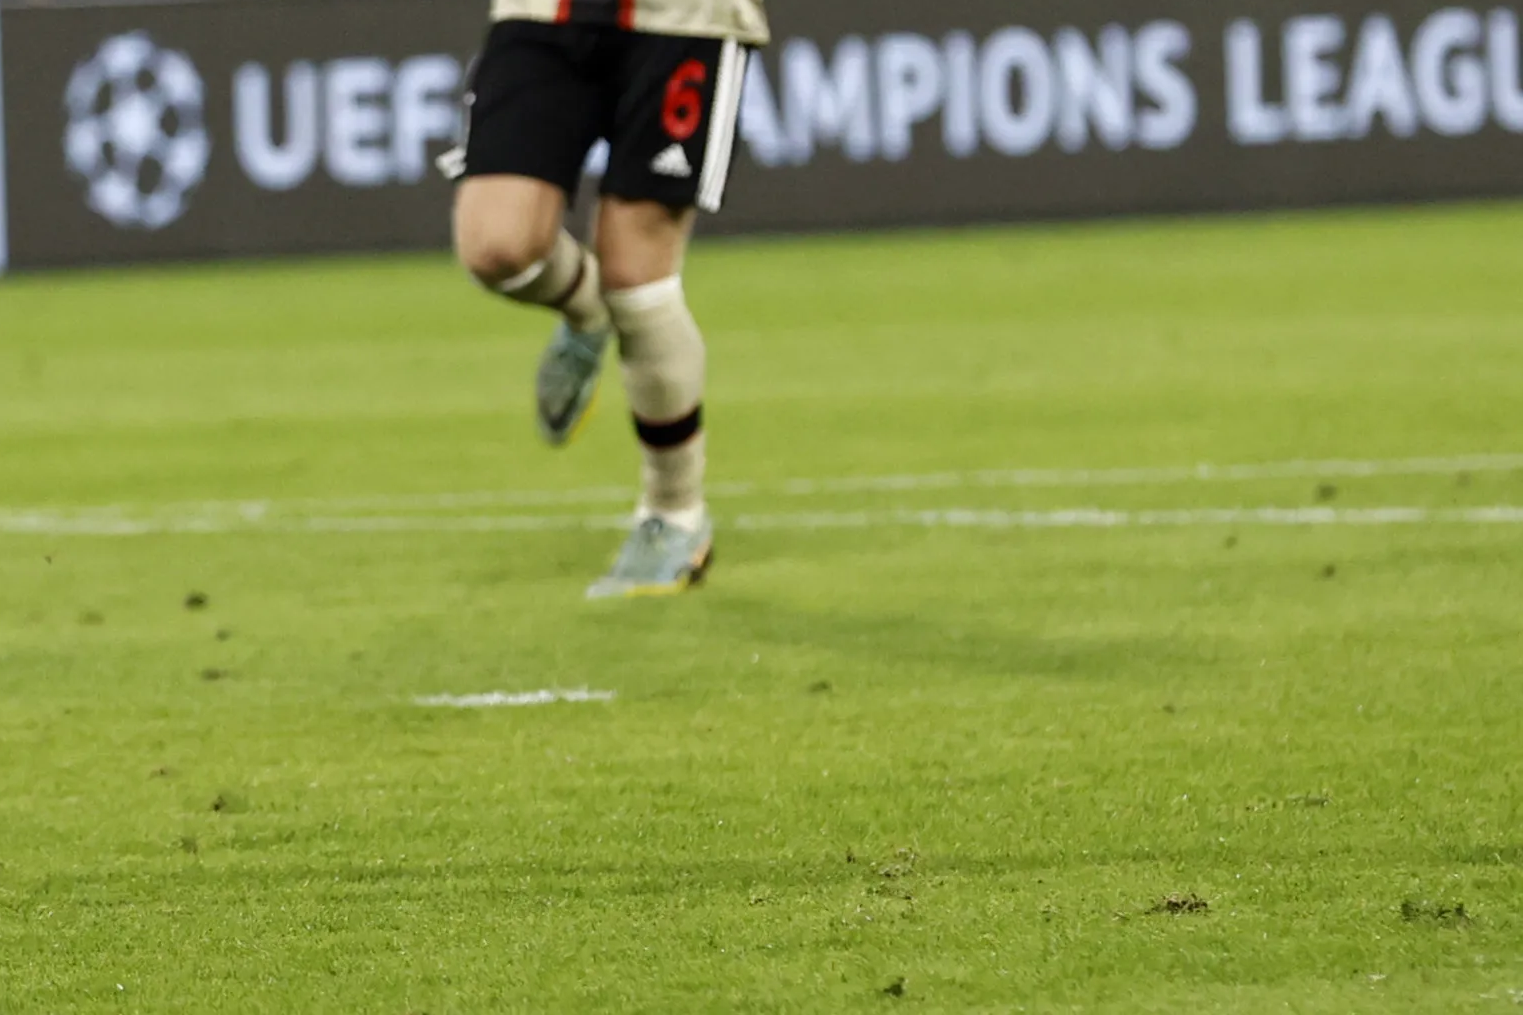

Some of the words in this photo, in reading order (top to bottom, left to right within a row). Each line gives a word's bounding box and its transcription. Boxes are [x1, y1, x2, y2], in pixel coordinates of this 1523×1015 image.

[232, 54, 465, 190] UEF
[735, 18, 1199, 168] AMPIONS
[661, 59, 707, 141] 6
